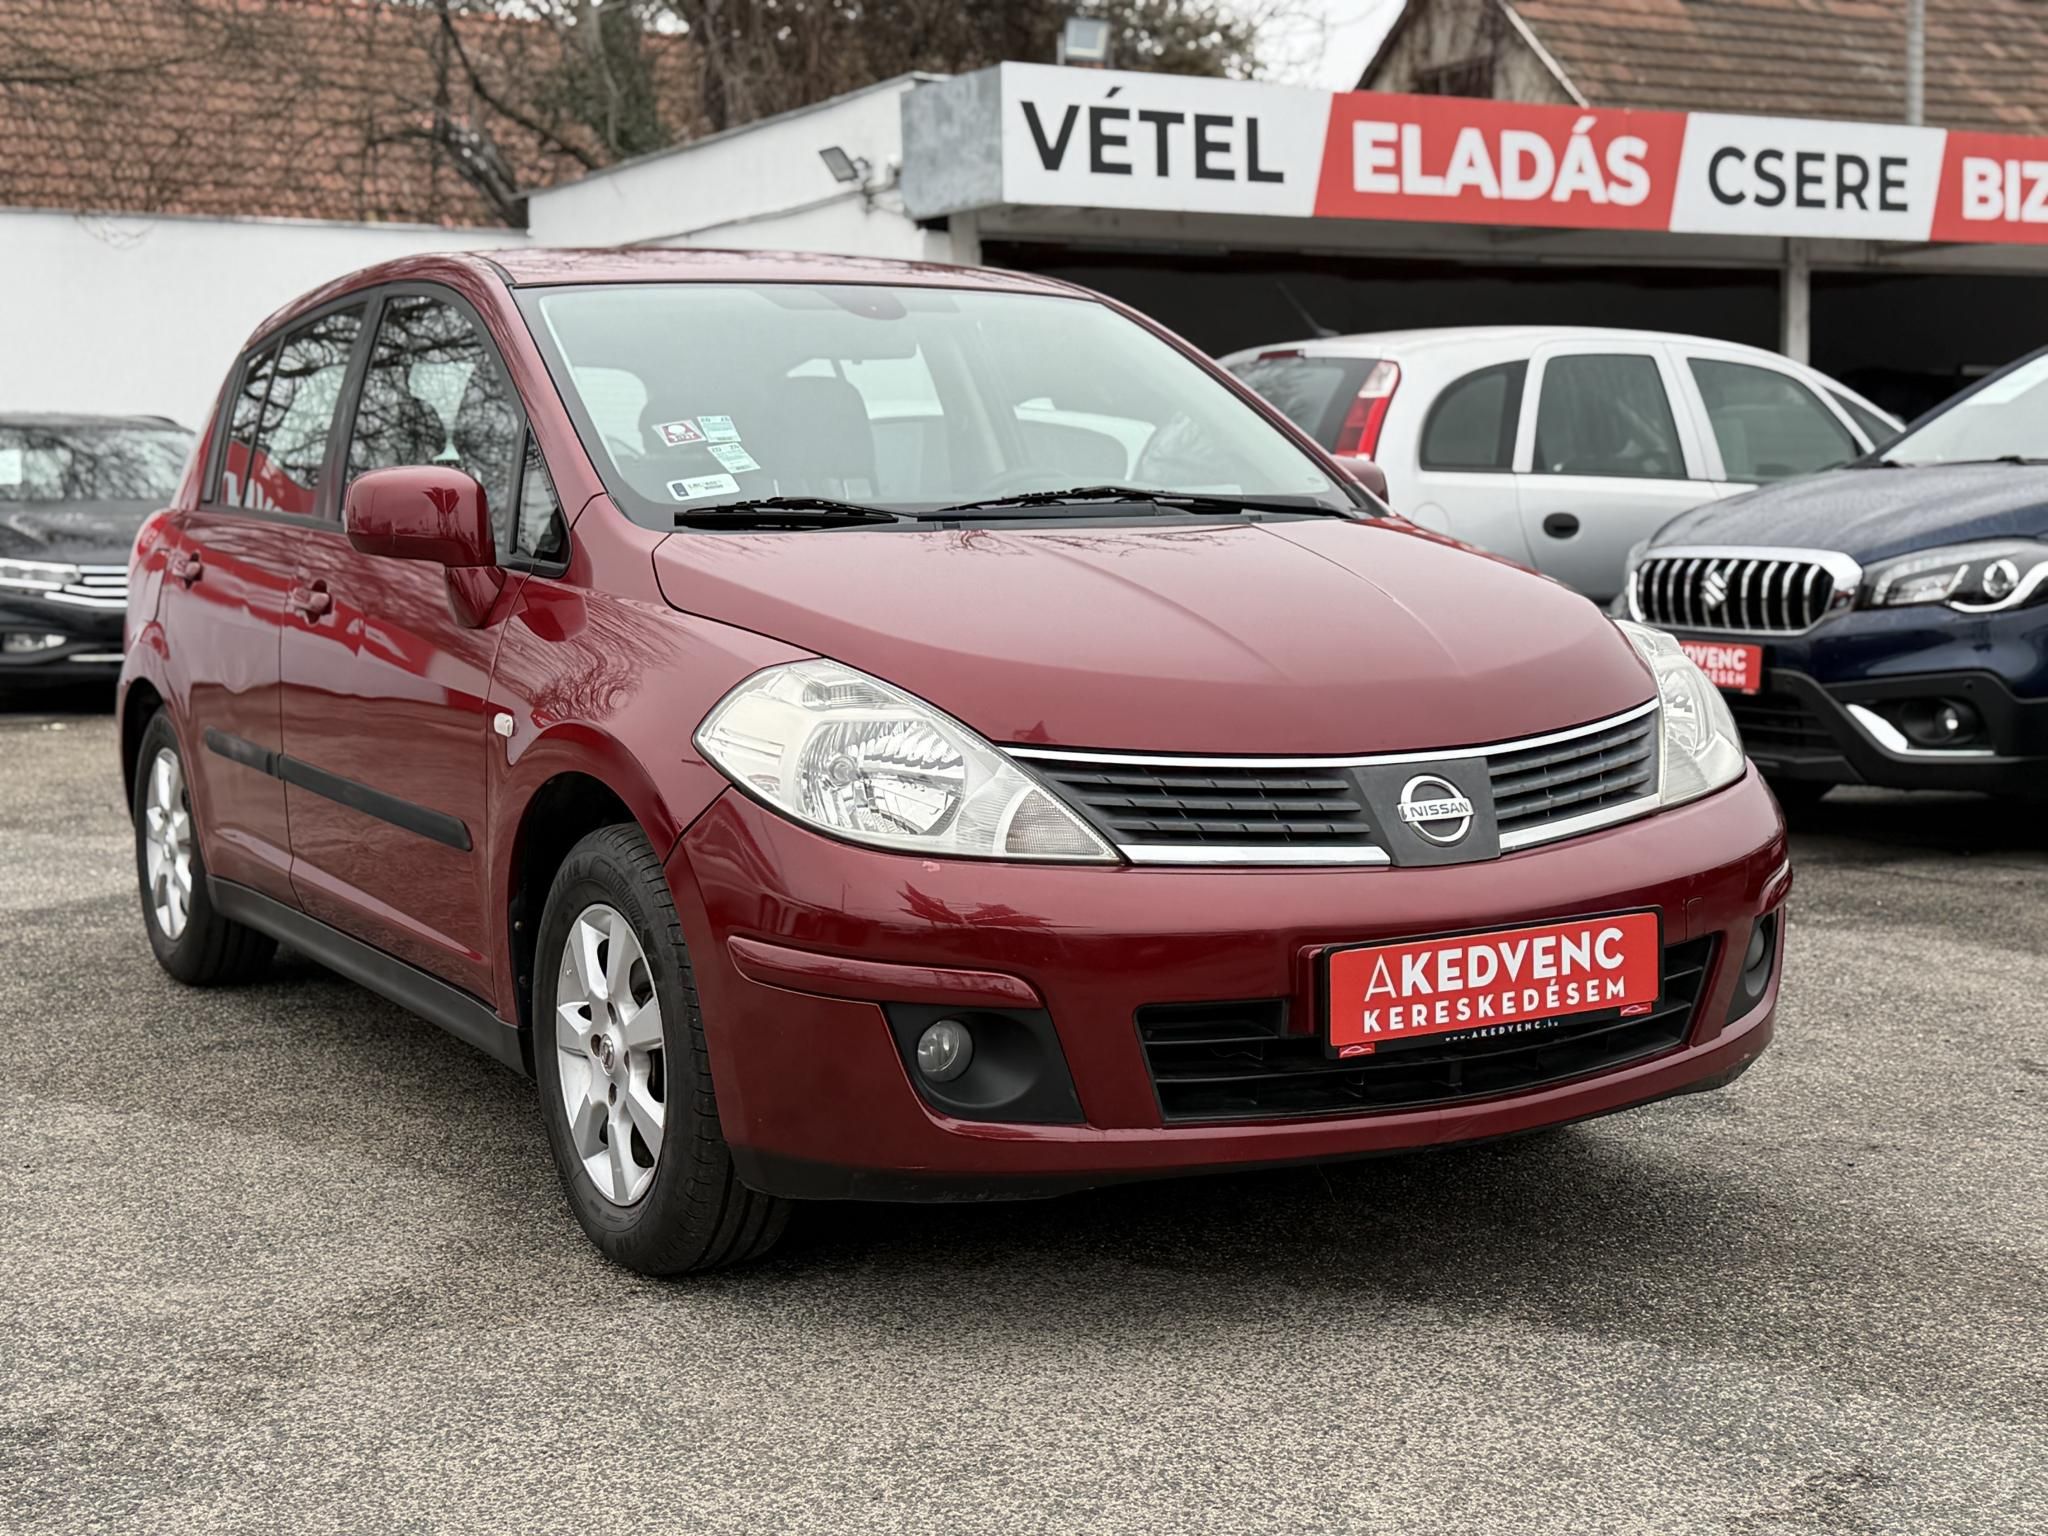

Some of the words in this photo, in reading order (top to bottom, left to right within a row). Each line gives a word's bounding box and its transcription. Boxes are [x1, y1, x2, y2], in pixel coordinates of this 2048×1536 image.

[1020, 86, 1285, 184] VÉTEL
[1352, 116, 1651, 206] ELADÁS
[1708, 146, 1908, 212] CSERE
[1680, 644, 1747, 672] DVENC
[1409, 801, 1469, 818] NISSAN
[1363, 927, 1625, 1002] AKEDVENC
[1363, 975, 1625, 1035] KERESKEDÉSEM
